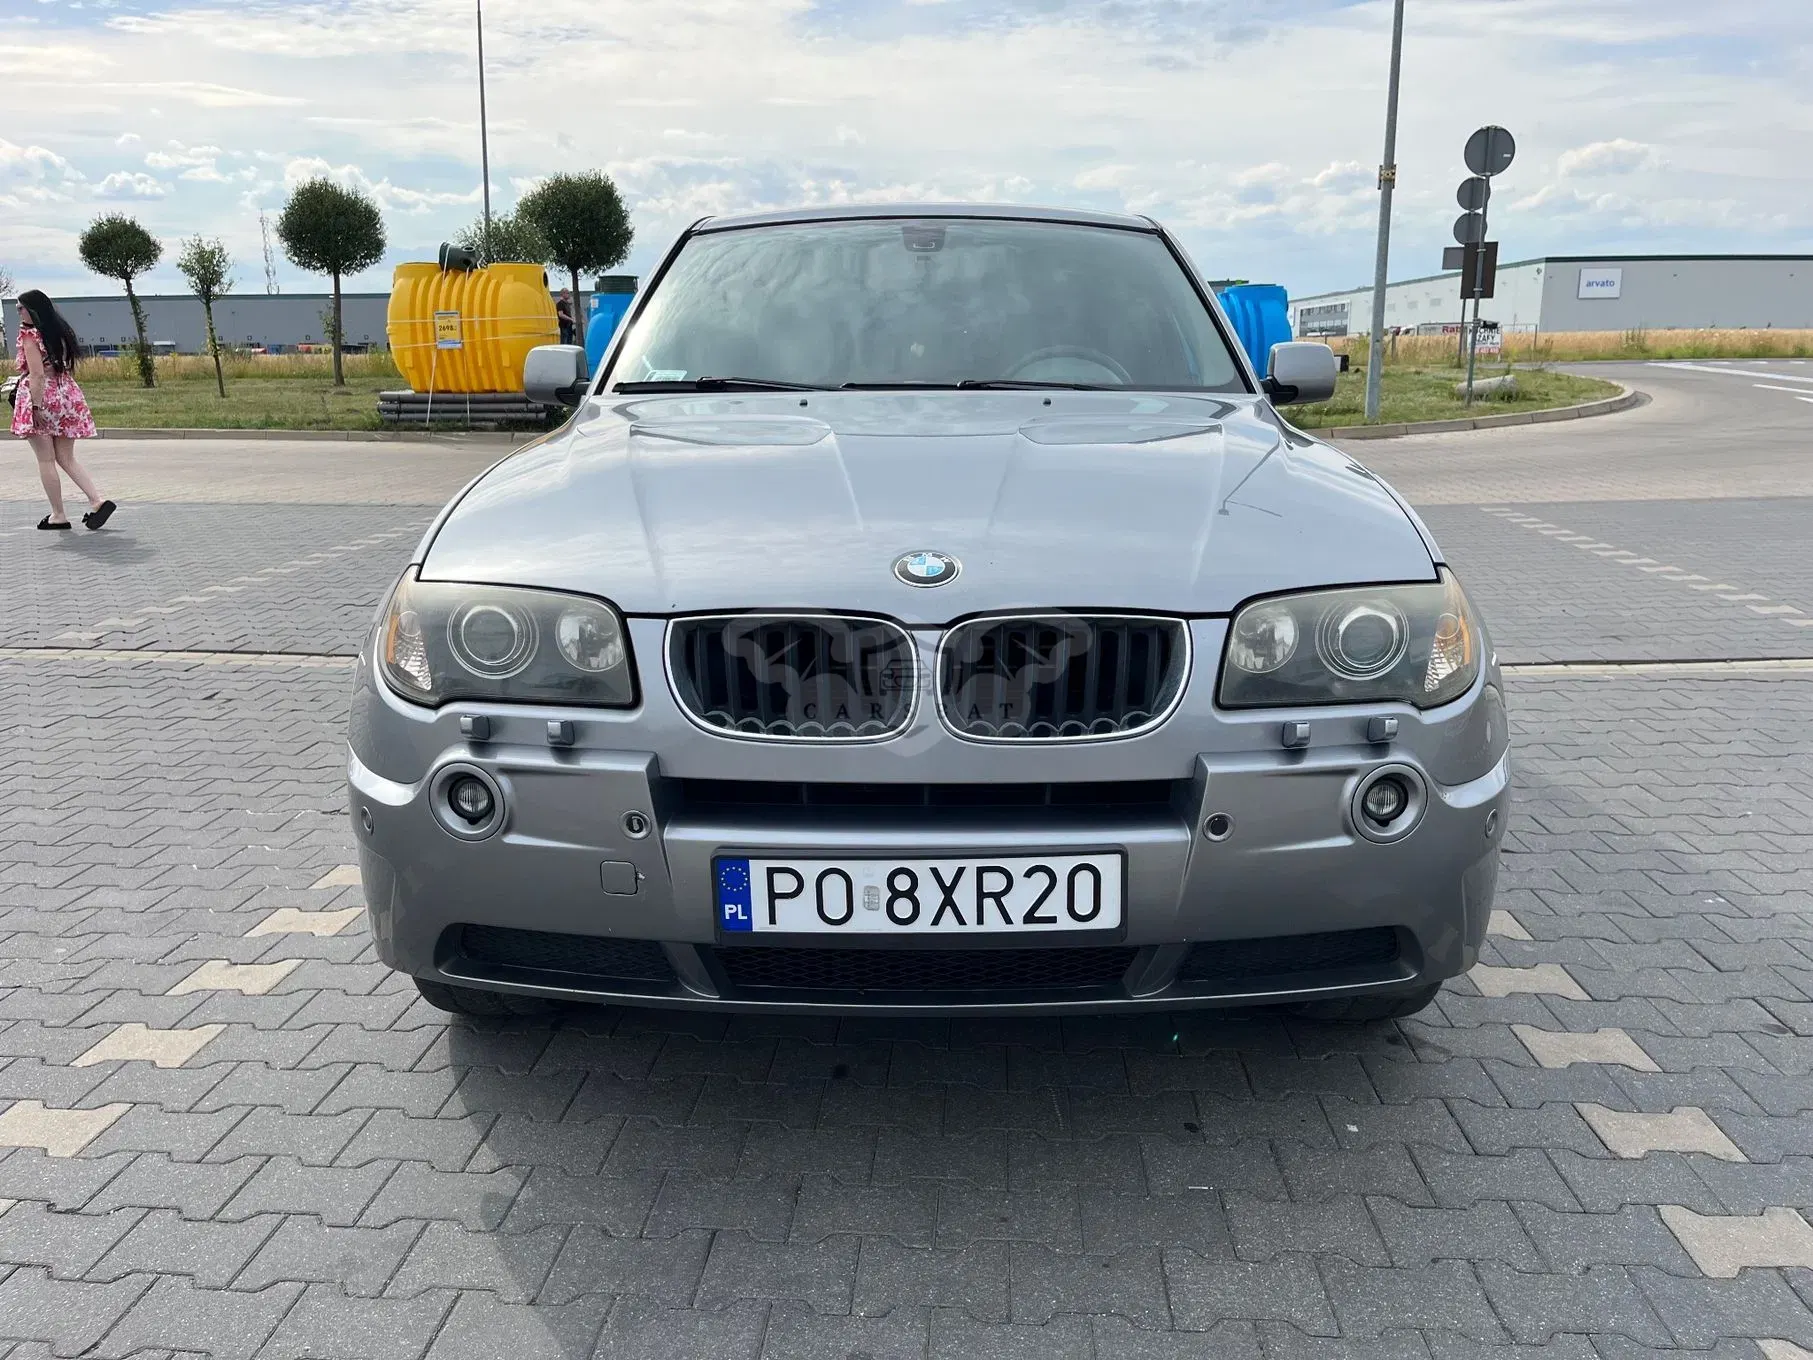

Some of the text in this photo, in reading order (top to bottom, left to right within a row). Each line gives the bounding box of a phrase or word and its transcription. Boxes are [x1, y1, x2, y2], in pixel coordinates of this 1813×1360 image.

[724, 904, 748, 920] PL
[765, 862, 1102, 926] PO 8XR20
